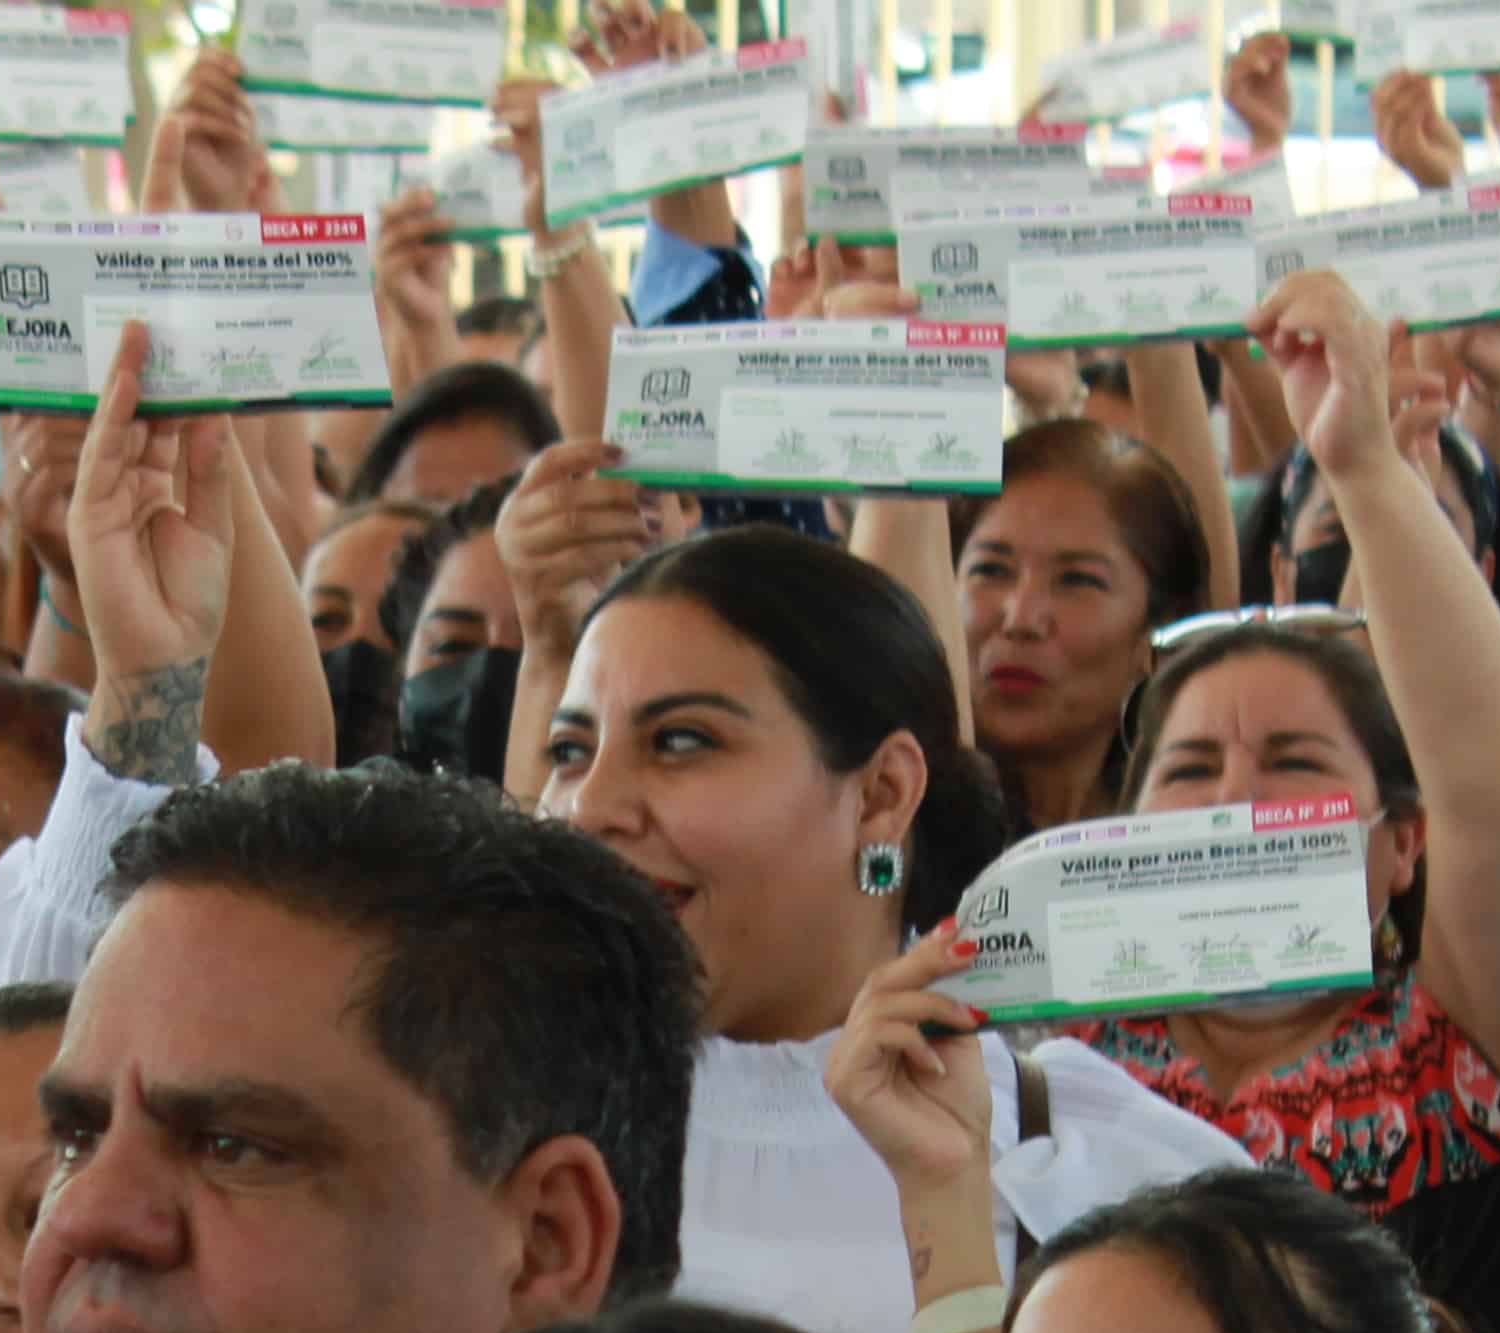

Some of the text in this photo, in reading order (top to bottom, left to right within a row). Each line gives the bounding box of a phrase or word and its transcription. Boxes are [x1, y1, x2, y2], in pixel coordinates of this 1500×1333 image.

[96, 253, 154, 268] Válido
[190, 256, 219, 268] una
[225, 254, 266, 268] Beca
[273, 253, 301, 267] del
[305, 253, 353, 267] 100%
[1255, 808, 1294, 827] BECA
[1062, 832, 1347, 875] Válido por una Beca del 100%
